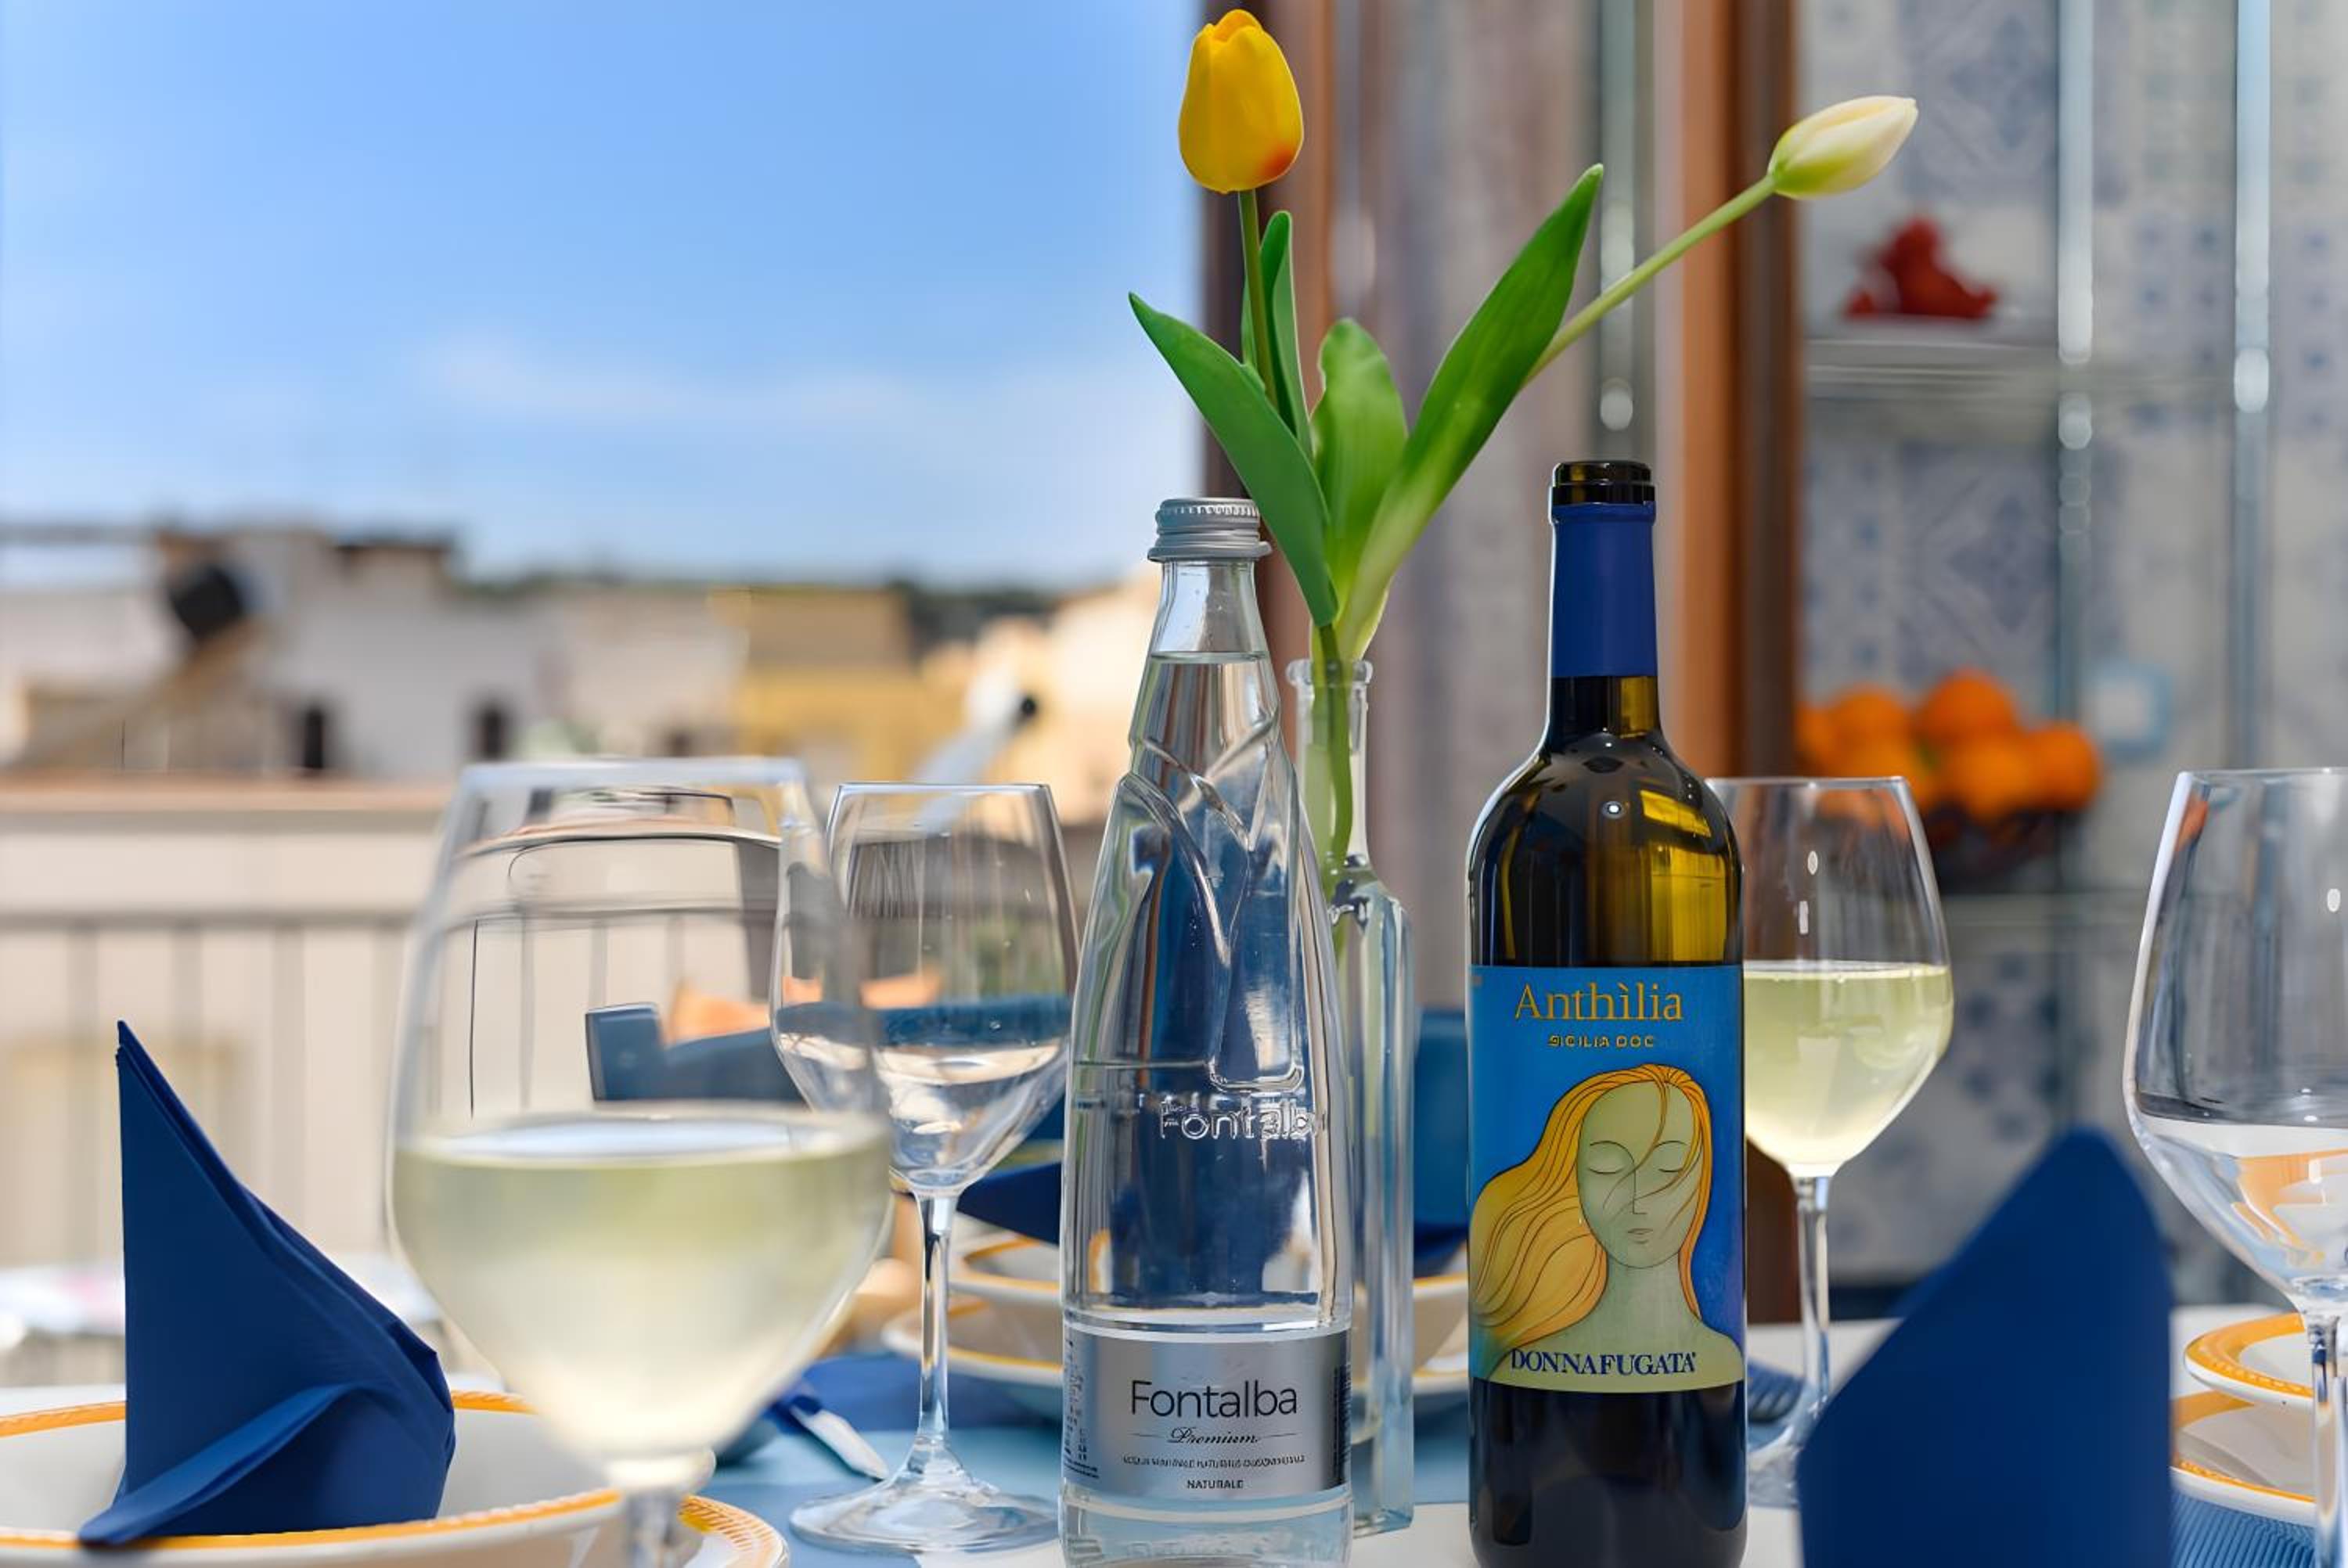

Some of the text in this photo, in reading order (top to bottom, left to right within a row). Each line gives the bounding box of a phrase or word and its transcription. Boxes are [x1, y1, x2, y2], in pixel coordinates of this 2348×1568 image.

[1515, 982, 1684, 1021] Anthìlia
[1615, 1035, 1654, 1048] DOC
[1160, 1097, 1314, 1139] Fontalb
[1131, 1379, 1298, 1419] Fontalba
[1187, 1479, 1245, 1490] NATURALE
